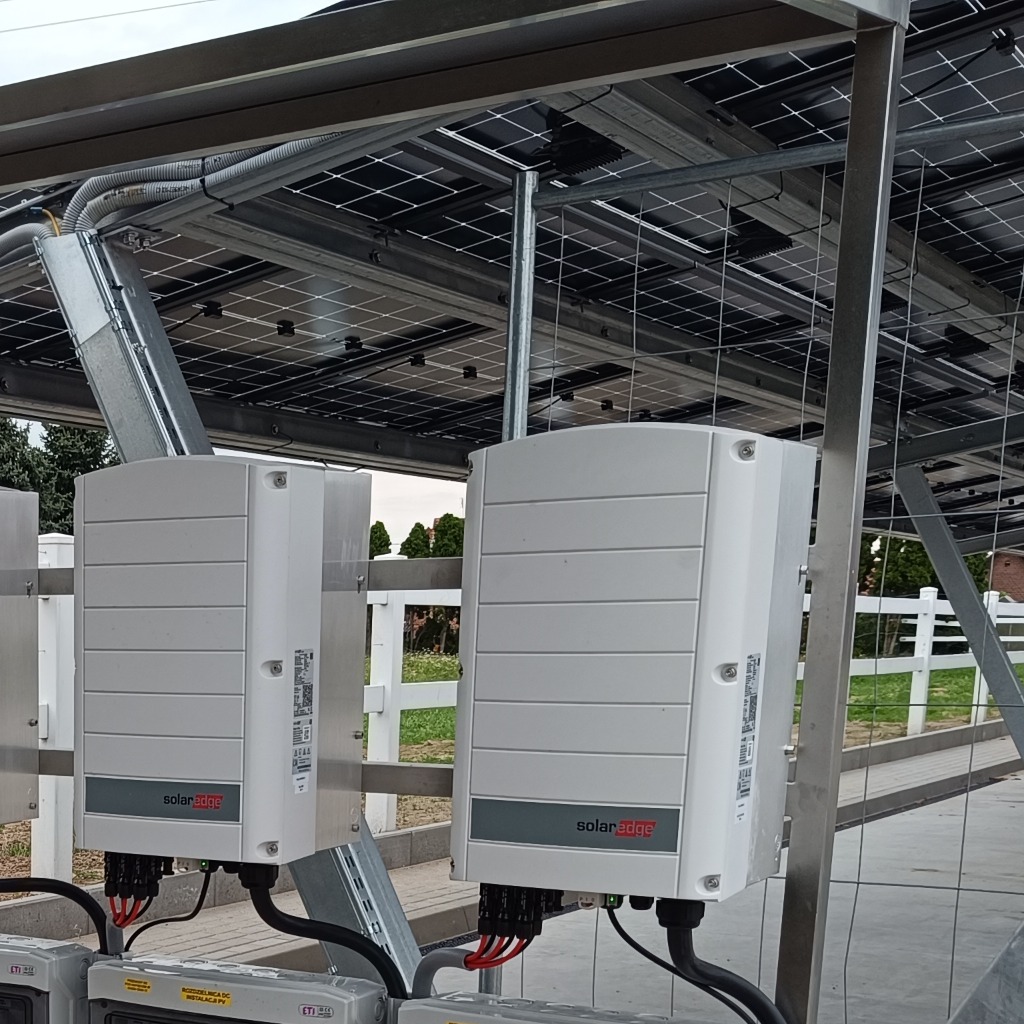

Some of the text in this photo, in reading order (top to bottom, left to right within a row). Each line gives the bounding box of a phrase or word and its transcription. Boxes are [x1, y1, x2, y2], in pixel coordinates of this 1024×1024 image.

[163, 793, 224, 809] solaredge
[577, 819, 654, 837] solaredge
[10, 966, 21, 974] ETI
[302, 1006, 315, 1015] ETI
